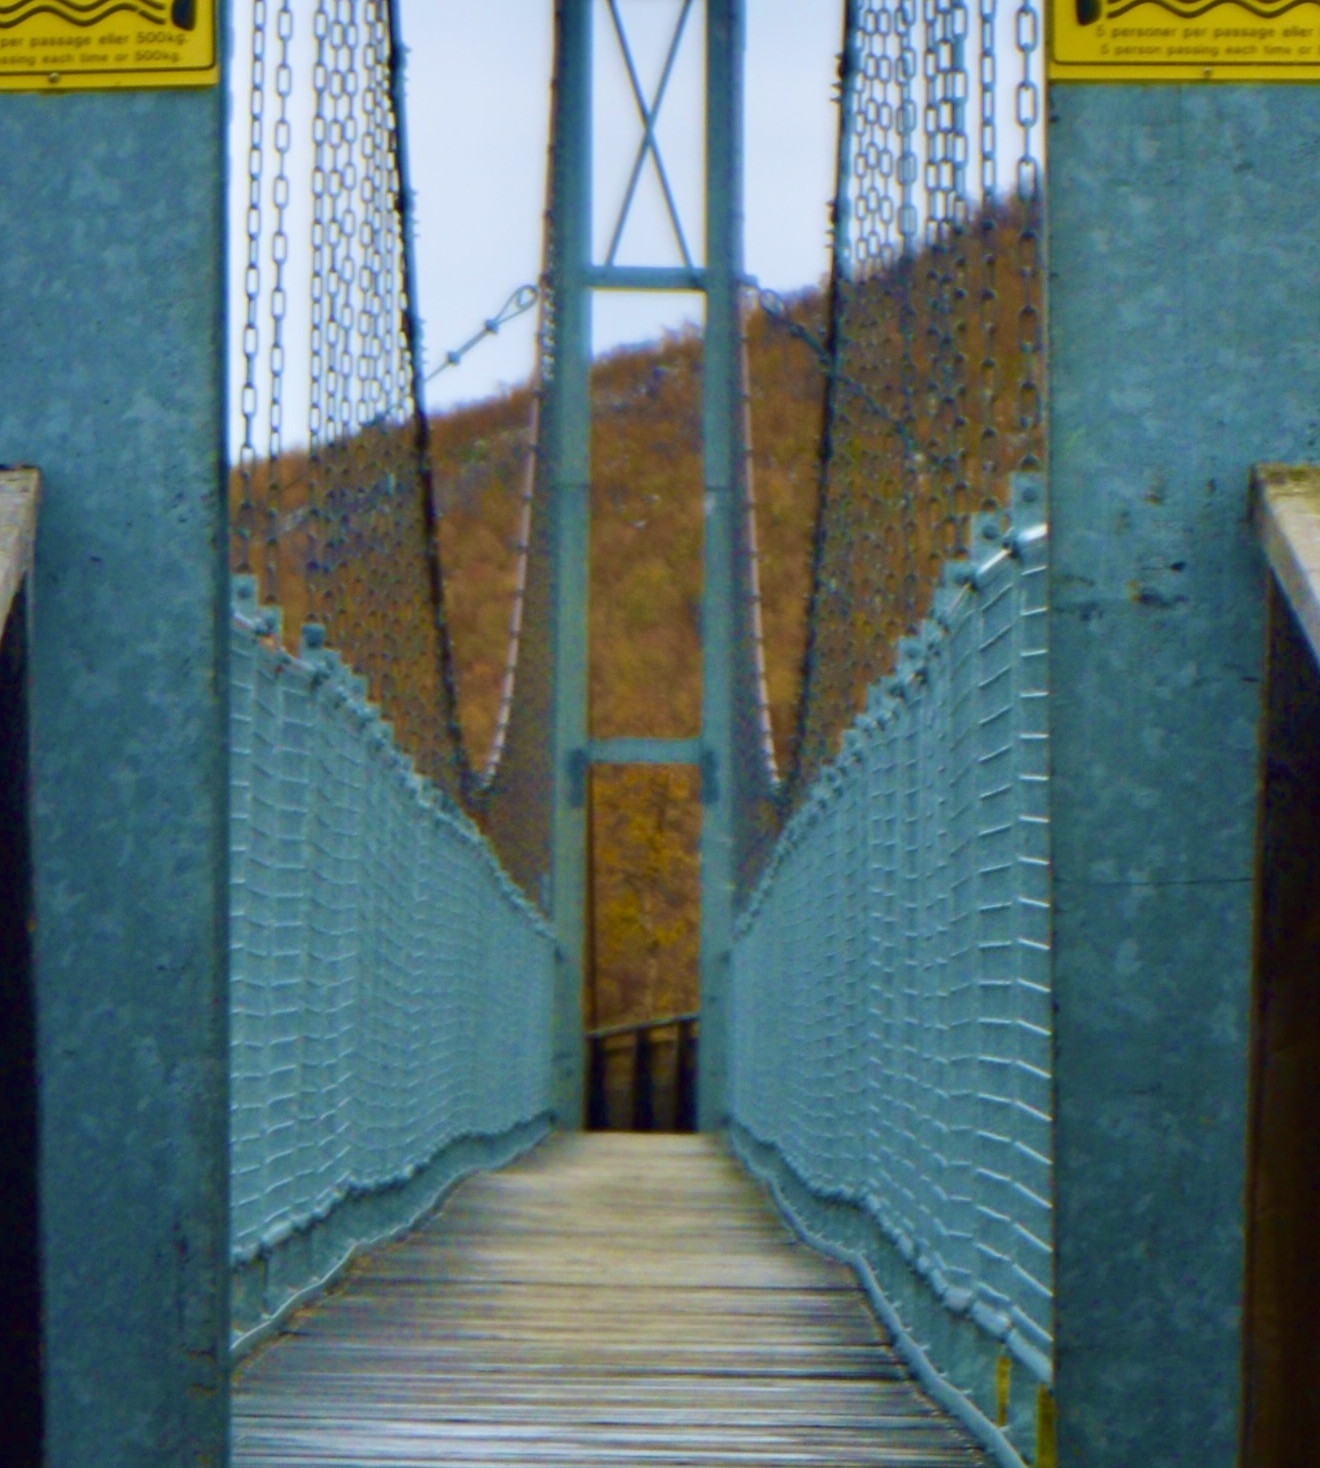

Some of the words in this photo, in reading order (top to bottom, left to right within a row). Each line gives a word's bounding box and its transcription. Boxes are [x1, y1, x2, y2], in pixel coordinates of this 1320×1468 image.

[1096, 25, 1104, 38] 5
[1111, 27, 1176, 39] personer
[1183, 27, 1206, 39] per
[1214, 27, 1275, 40] passage
[0, 37, 24, 50] per
[30, 36, 92, 49] passage
[98, 33, 129, 45] eller
[1100, 43, 1109, 55] 5
[1167, 44, 1219, 57] passing
[1225, 43, 1257, 55] each
[1298, 45, 1312, 55] or
[42, 53, 73, 64] each
[79, 52, 108, 63] time
[115, 53, 128, 62] or
